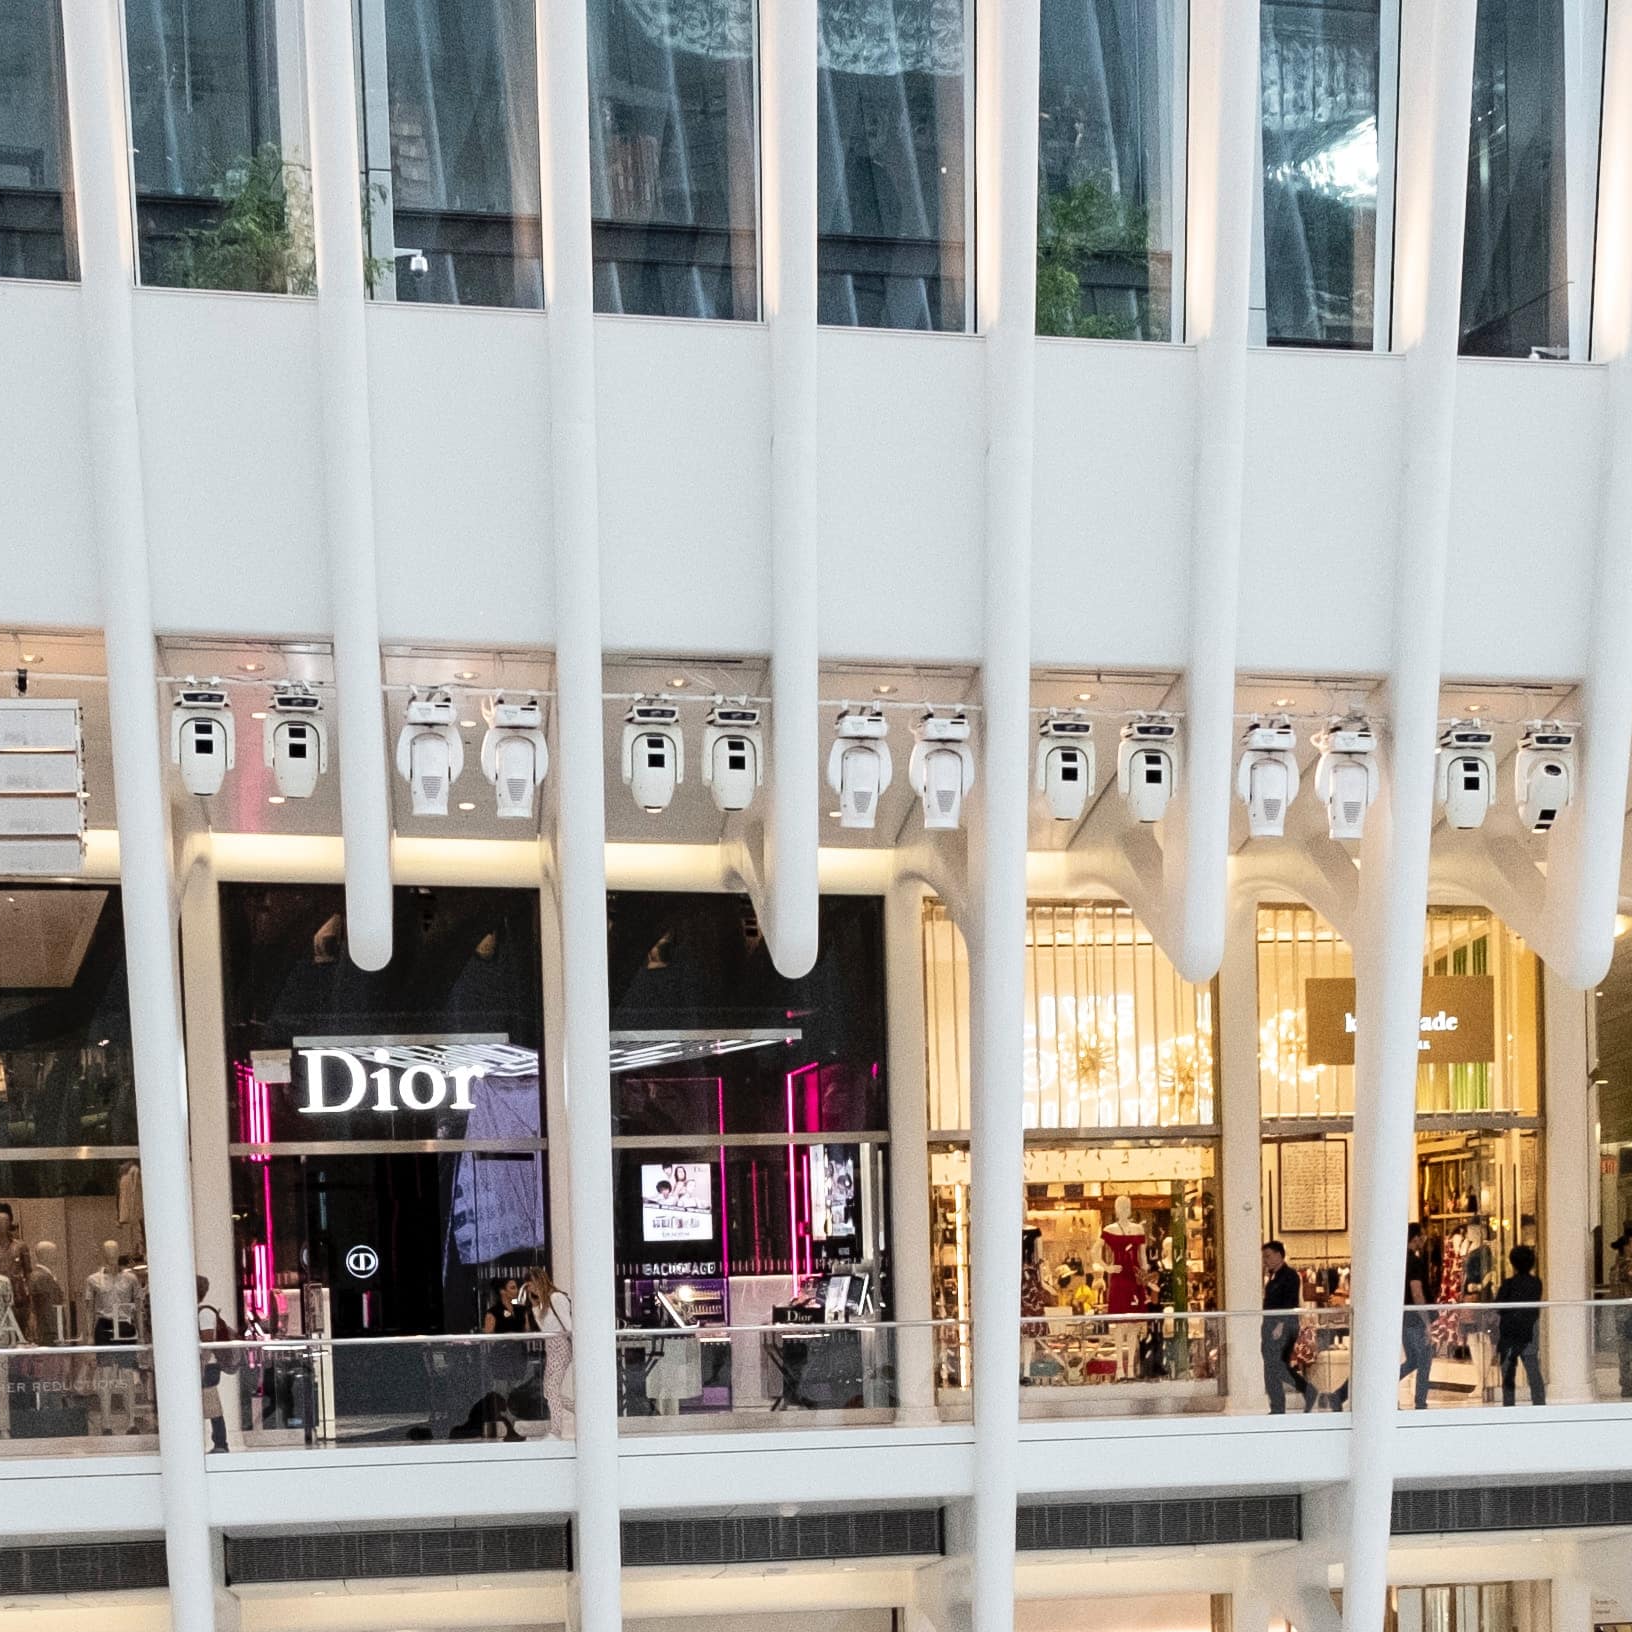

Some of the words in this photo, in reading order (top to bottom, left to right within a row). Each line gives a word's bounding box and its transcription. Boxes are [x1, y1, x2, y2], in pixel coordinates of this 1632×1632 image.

[1420, 1010, 1459, 1031] ade
[298, 1049, 485, 1113] Dior
[786, 1308, 814, 1322] Dior
[31, 1379, 129, 1394] REDUCTIONS
